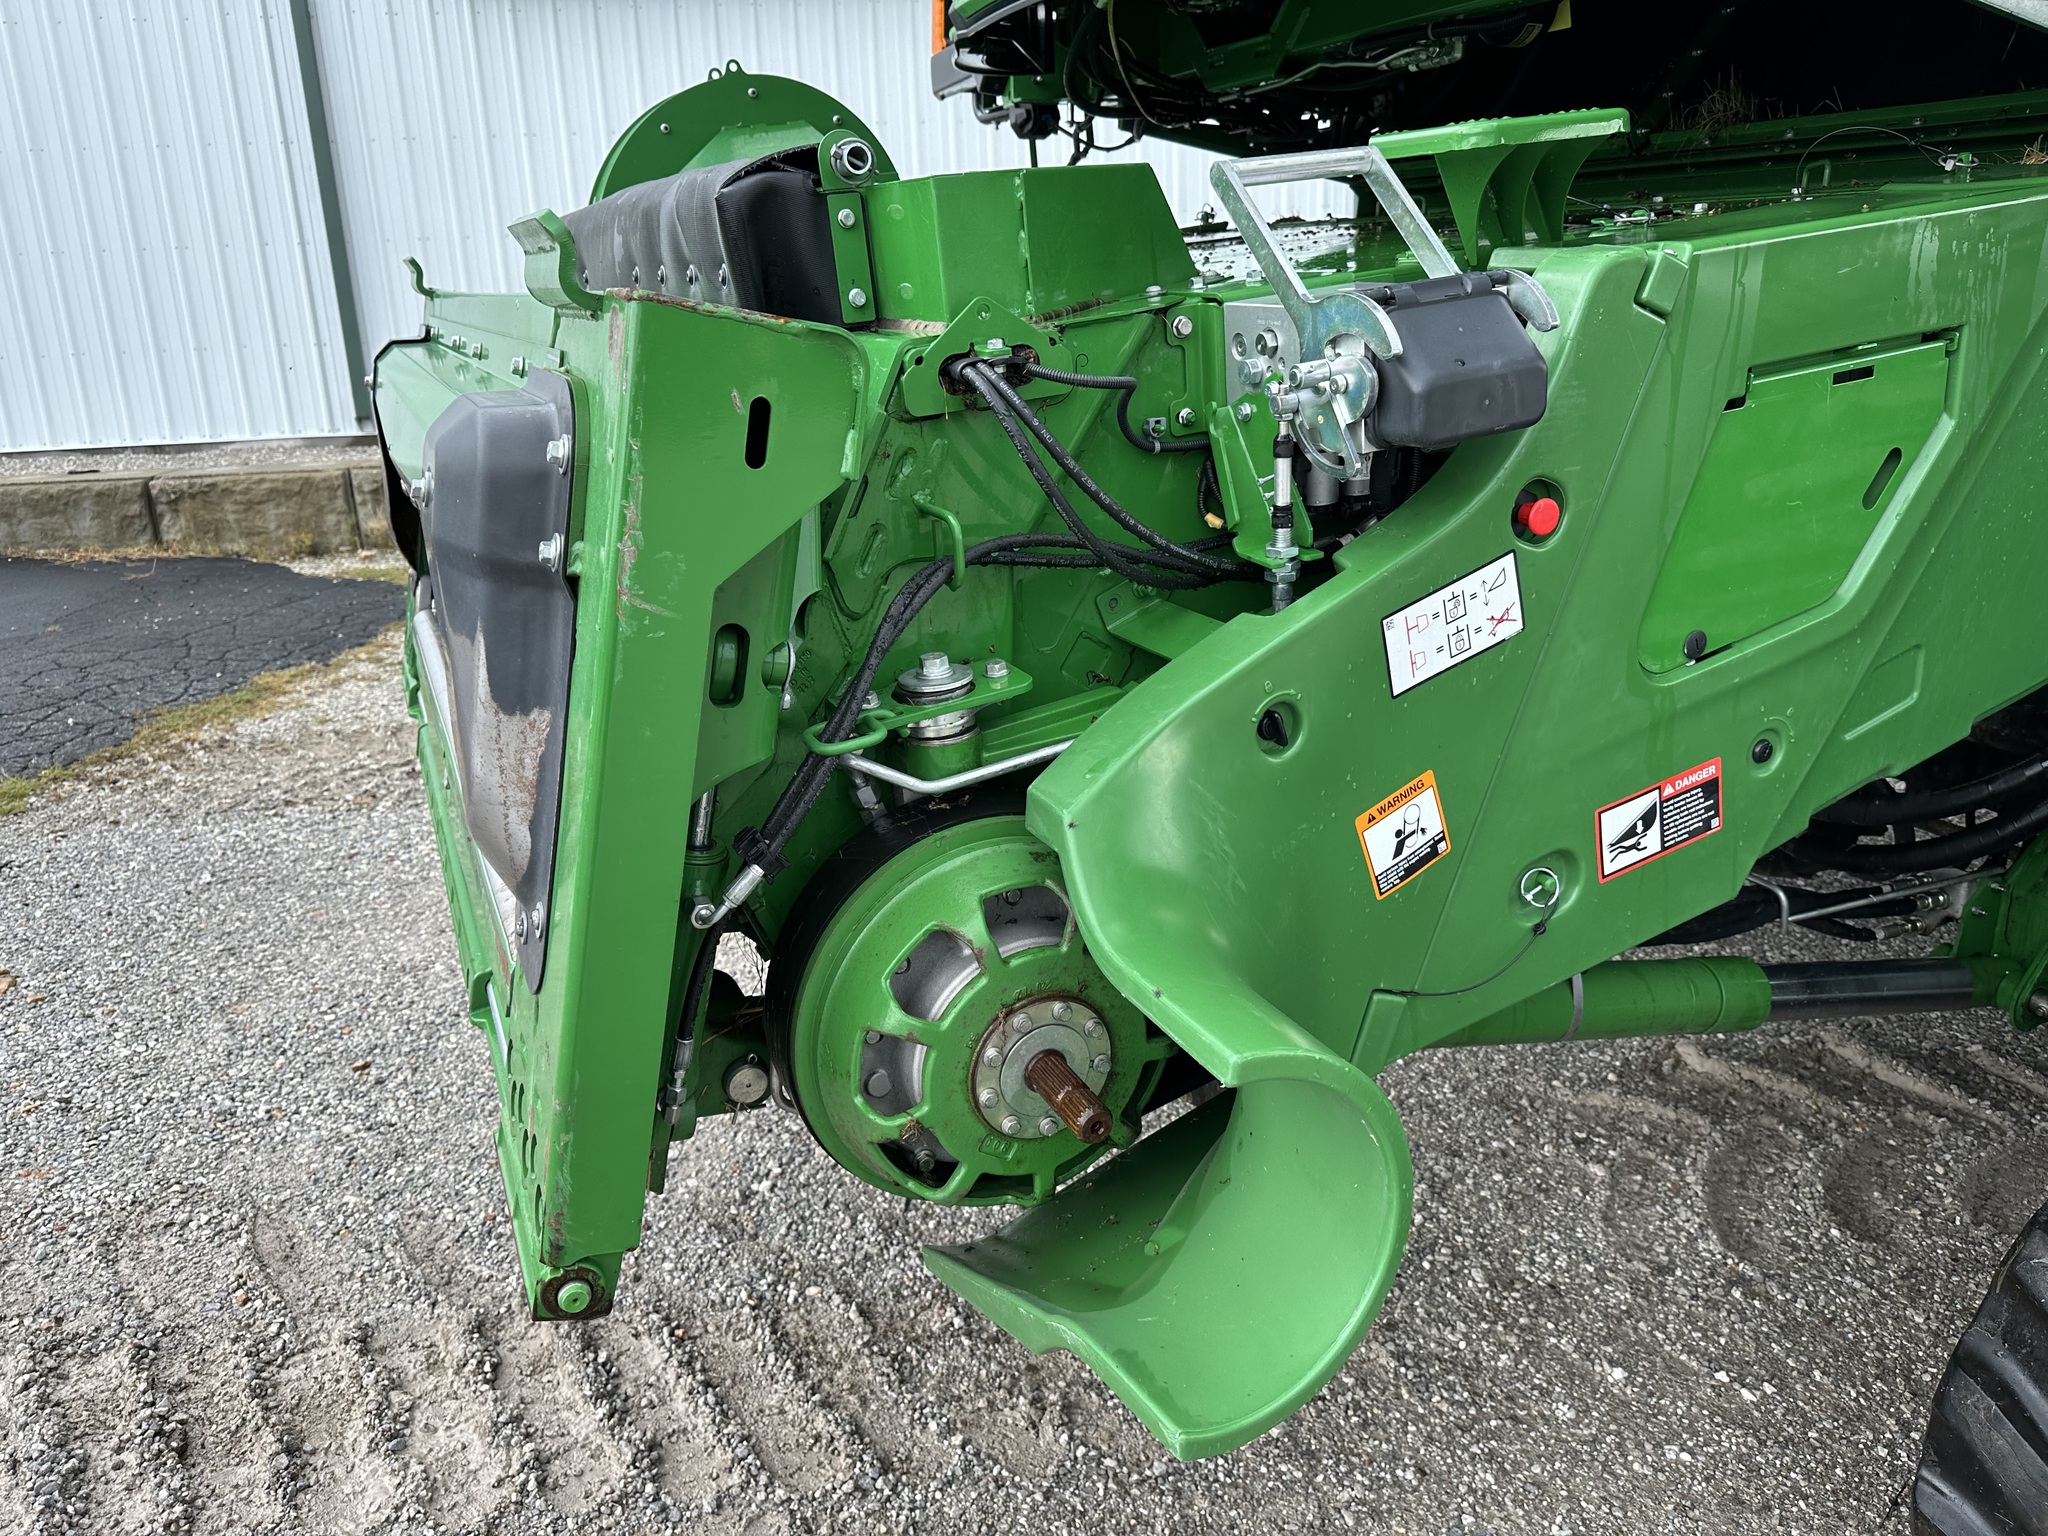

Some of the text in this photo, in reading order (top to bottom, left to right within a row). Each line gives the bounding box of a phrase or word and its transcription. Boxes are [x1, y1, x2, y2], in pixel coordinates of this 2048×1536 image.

[1000, 381, 1022, 405] MSHA
[1041, 429, 1054, 443] DN
[1063, 455, 1080, 473] 1SC
[1081, 476, 1098, 492] 857
[1099, 492, 1111, 505] EN
[1120, 512, 1135, 526] R17
[1137, 524, 1151, 537] 100
[1675, 765, 1716, 790] DANGER
[1376, 779, 1425, 816] WARNING
